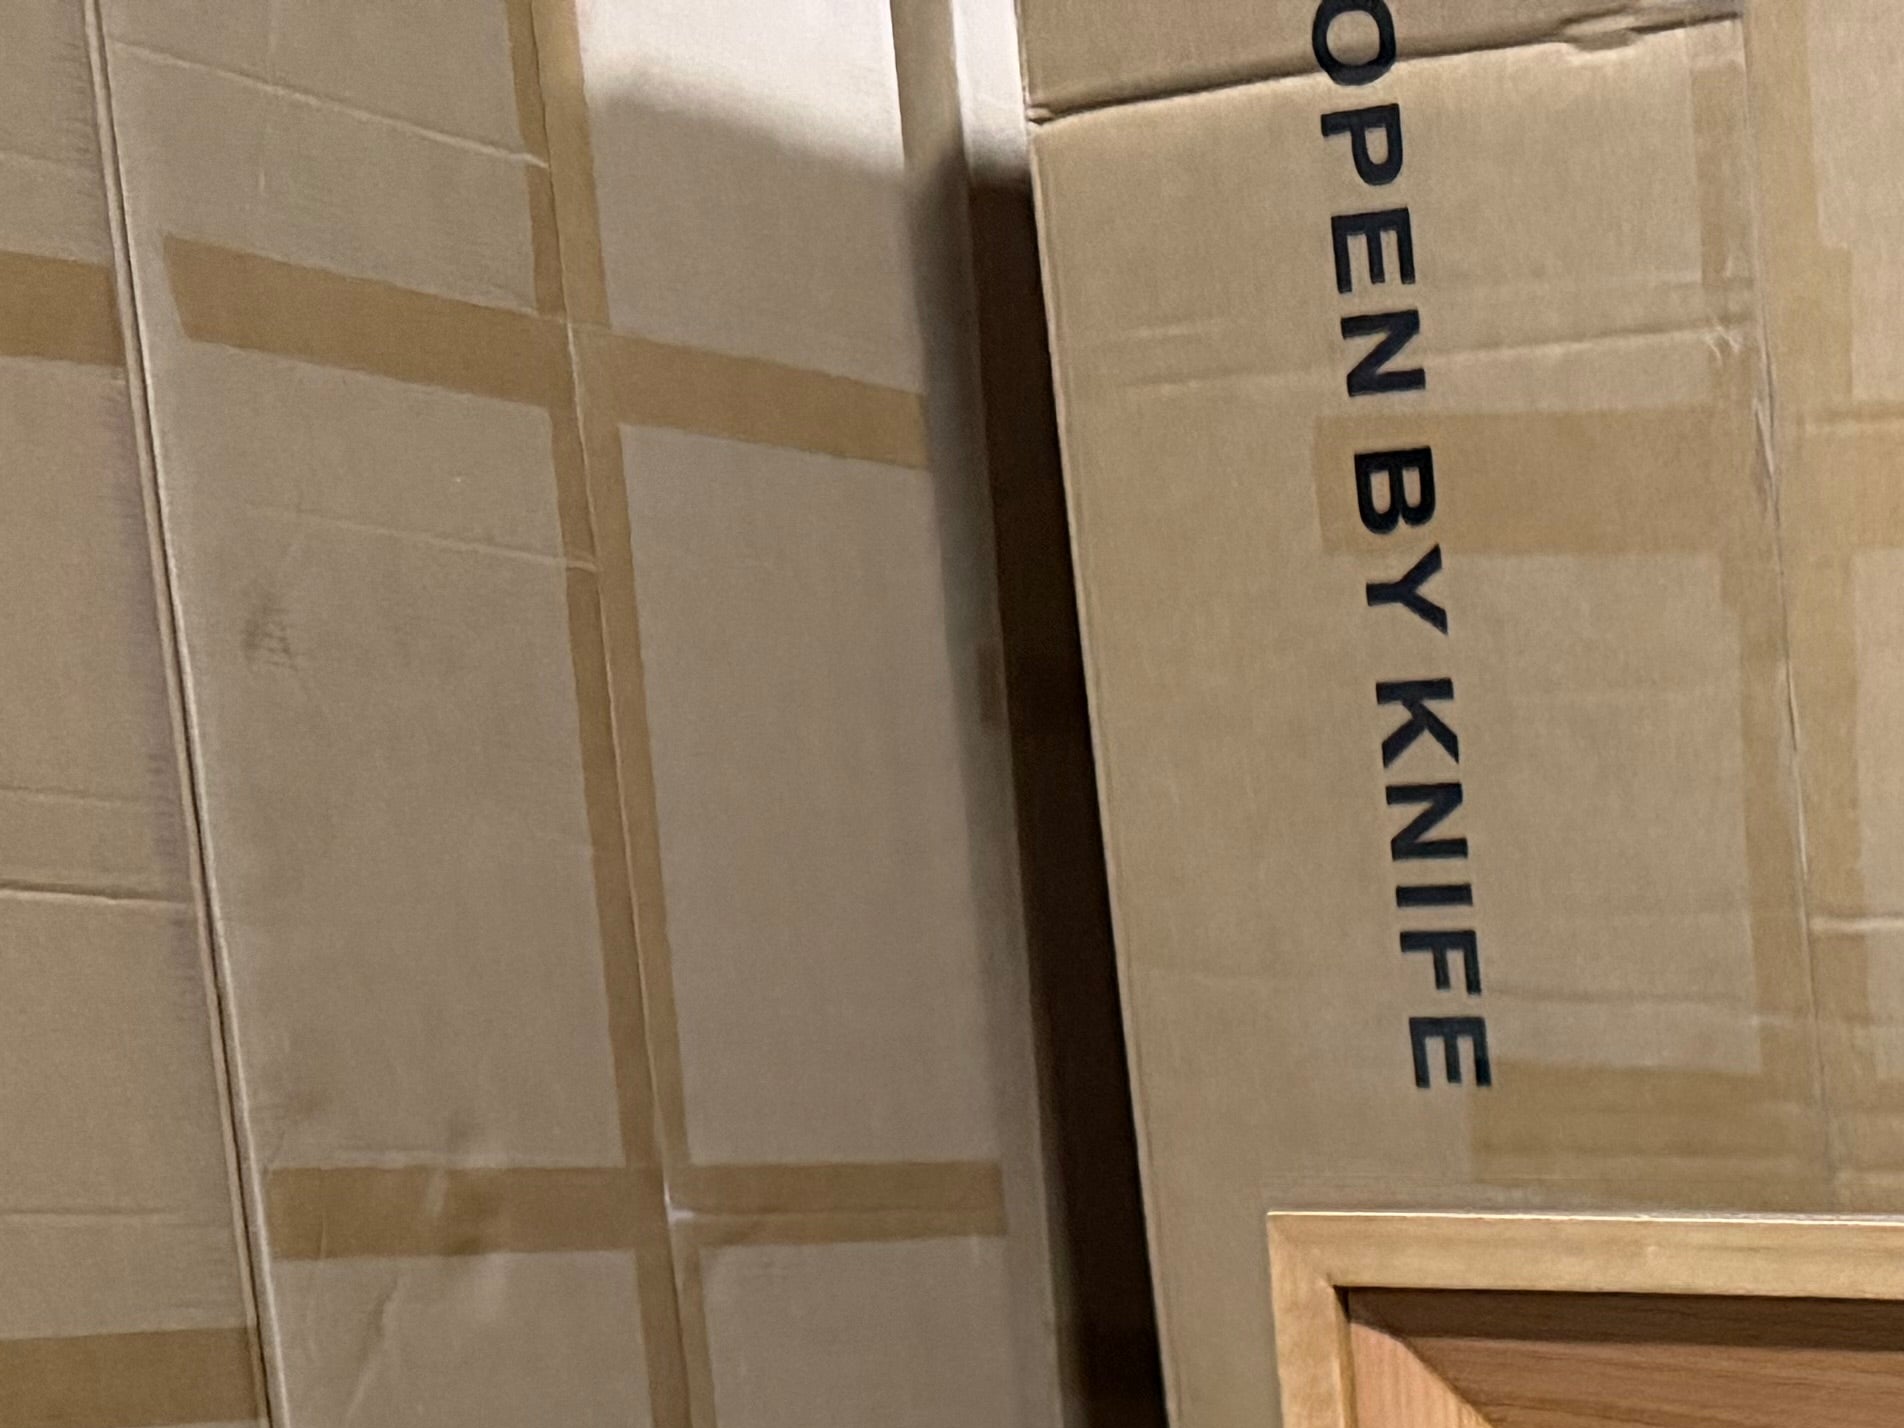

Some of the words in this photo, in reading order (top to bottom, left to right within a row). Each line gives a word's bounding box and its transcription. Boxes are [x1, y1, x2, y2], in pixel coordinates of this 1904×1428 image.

[1311, 0, 1426, 398] OPEN
[1353, 445, 1448, 634] BY
[1375, 677, 1492, 1089] KNIFE
